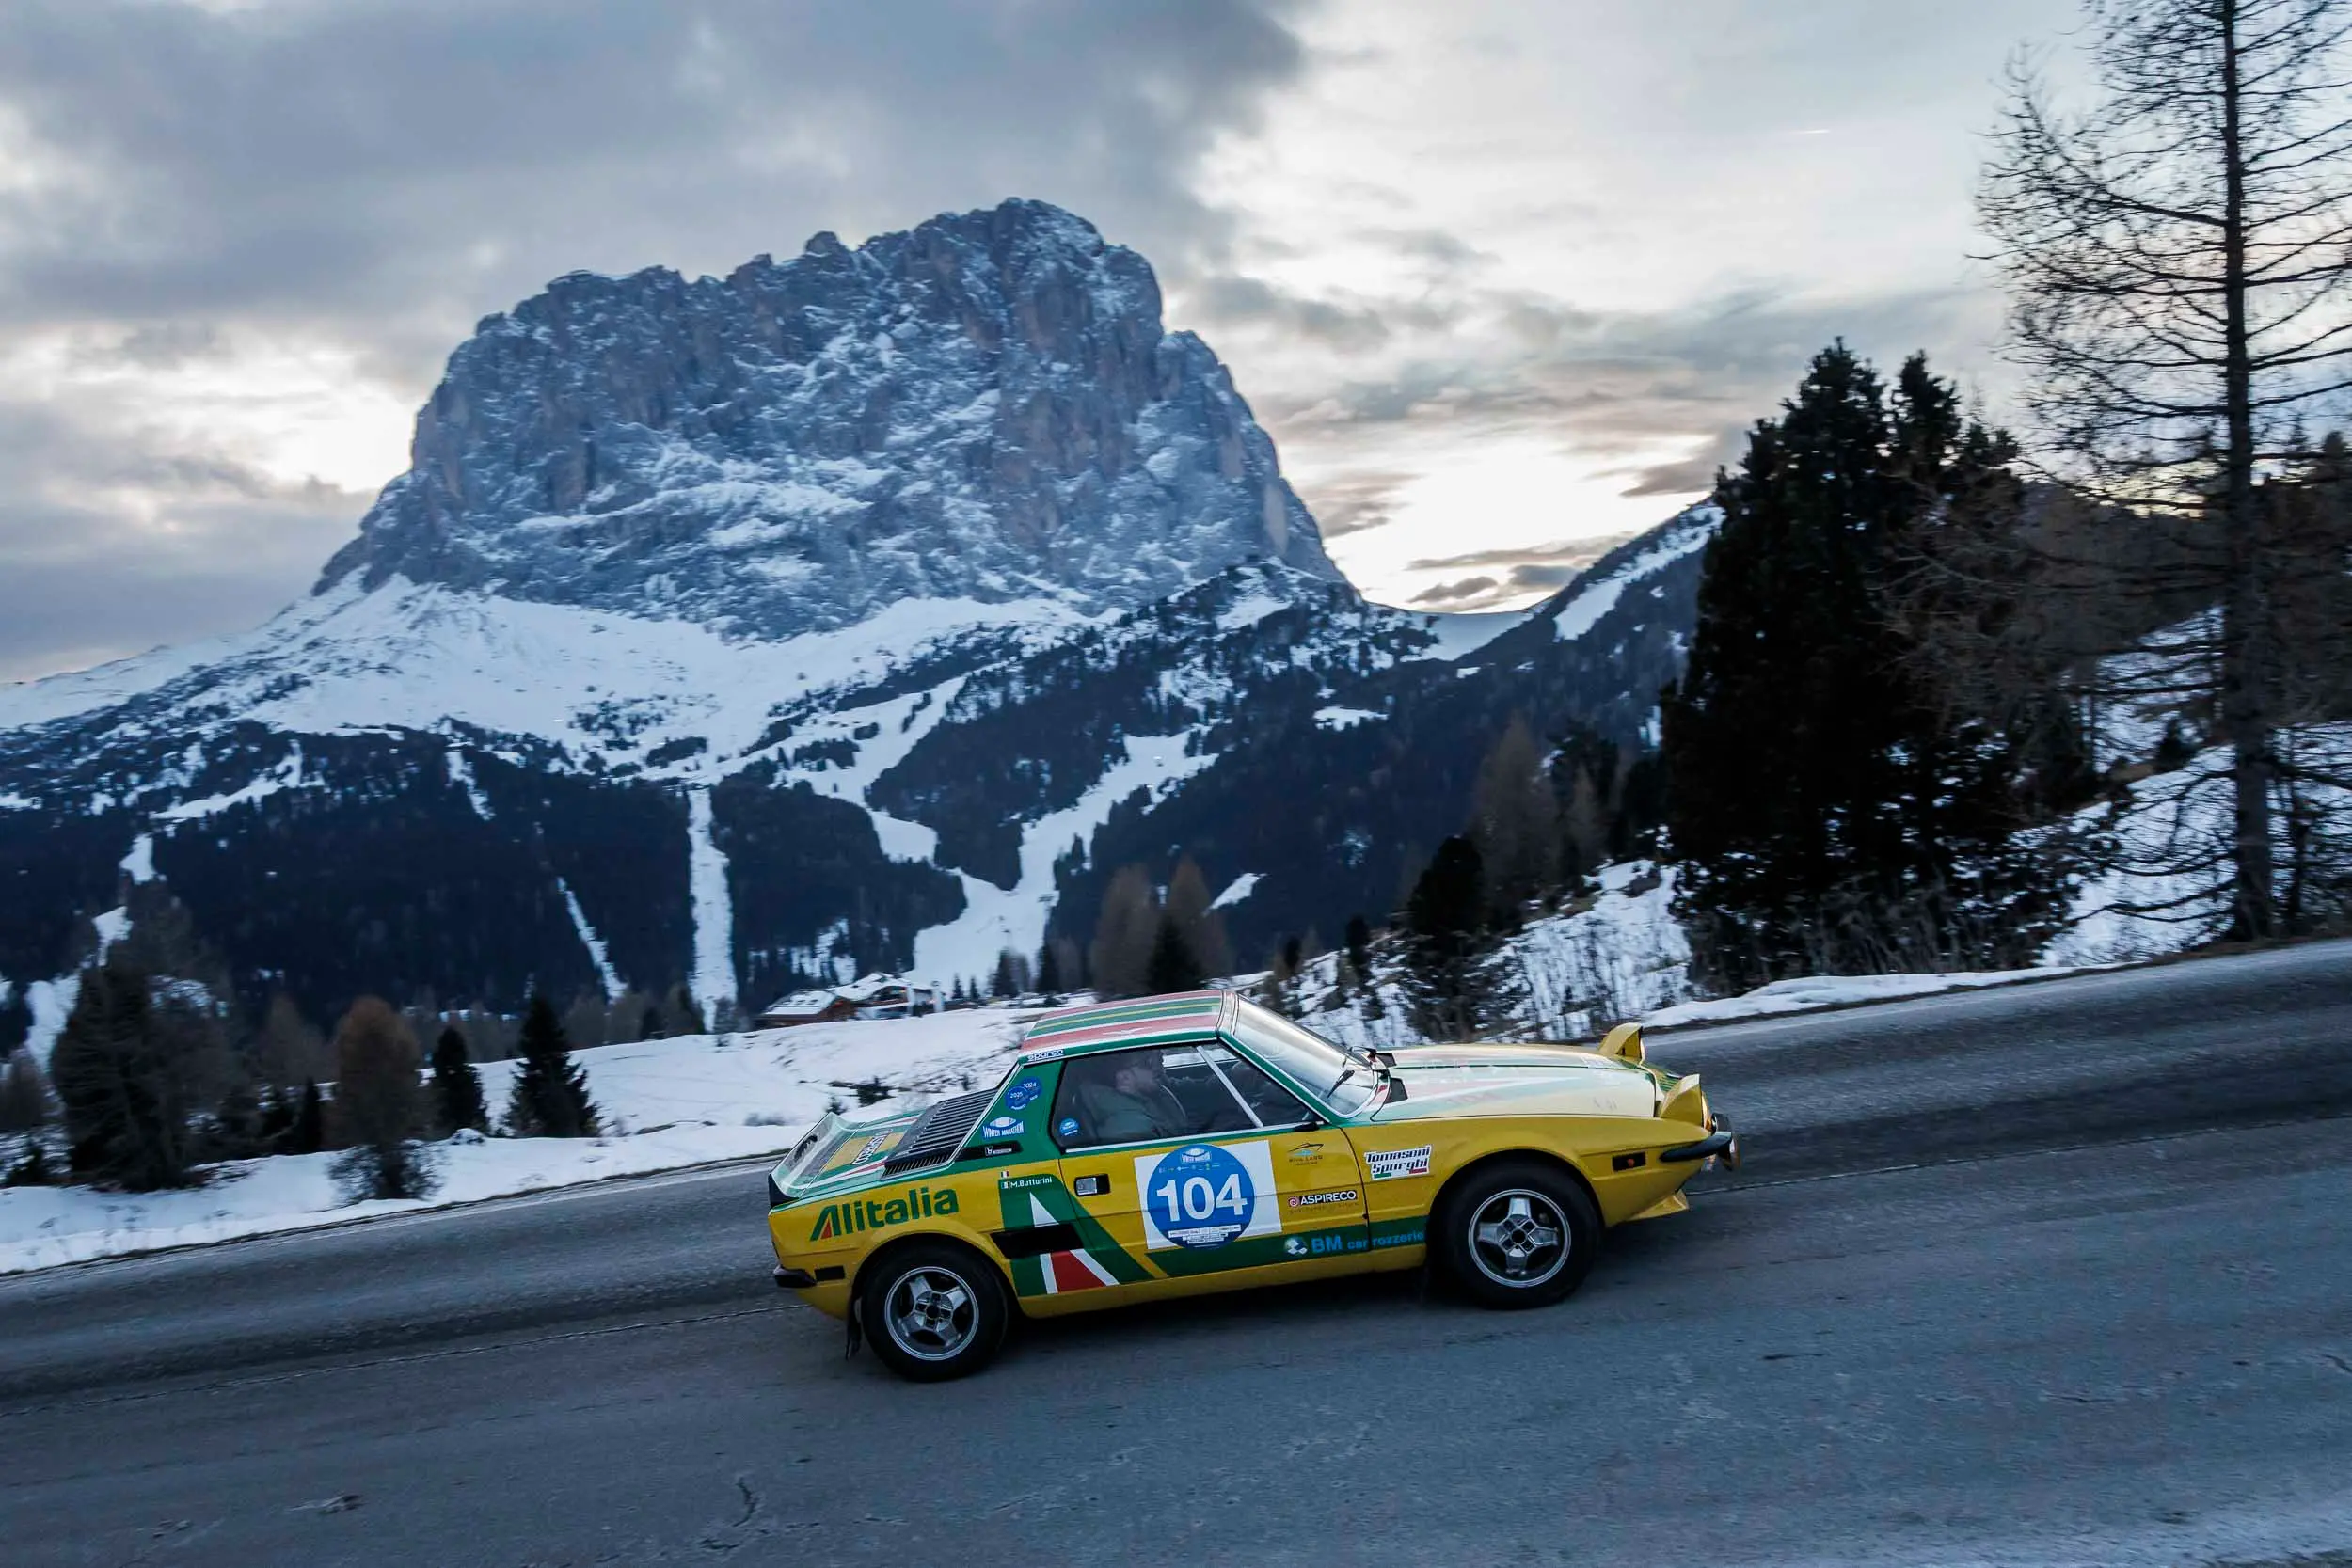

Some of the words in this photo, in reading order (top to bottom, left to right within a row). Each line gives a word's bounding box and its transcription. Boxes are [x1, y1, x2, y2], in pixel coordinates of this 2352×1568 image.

[983, 1126, 1001, 1138] WINTER
[1001, 1121, 1025, 1136] MARATHON
[1367, 1146, 1430, 1163] Tomasoni
[1373, 1158, 1428, 1174] Spurghi
[1010, 1177, 1052, 1188] M.Butturini
[1156, 1173, 1248, 1222] 104
[1300, 1190, 1357, 1206] ASPIRECO
[810, 1186, 959, 1242] Alitalia
[1311, 1235, 1343, 1253] BM
